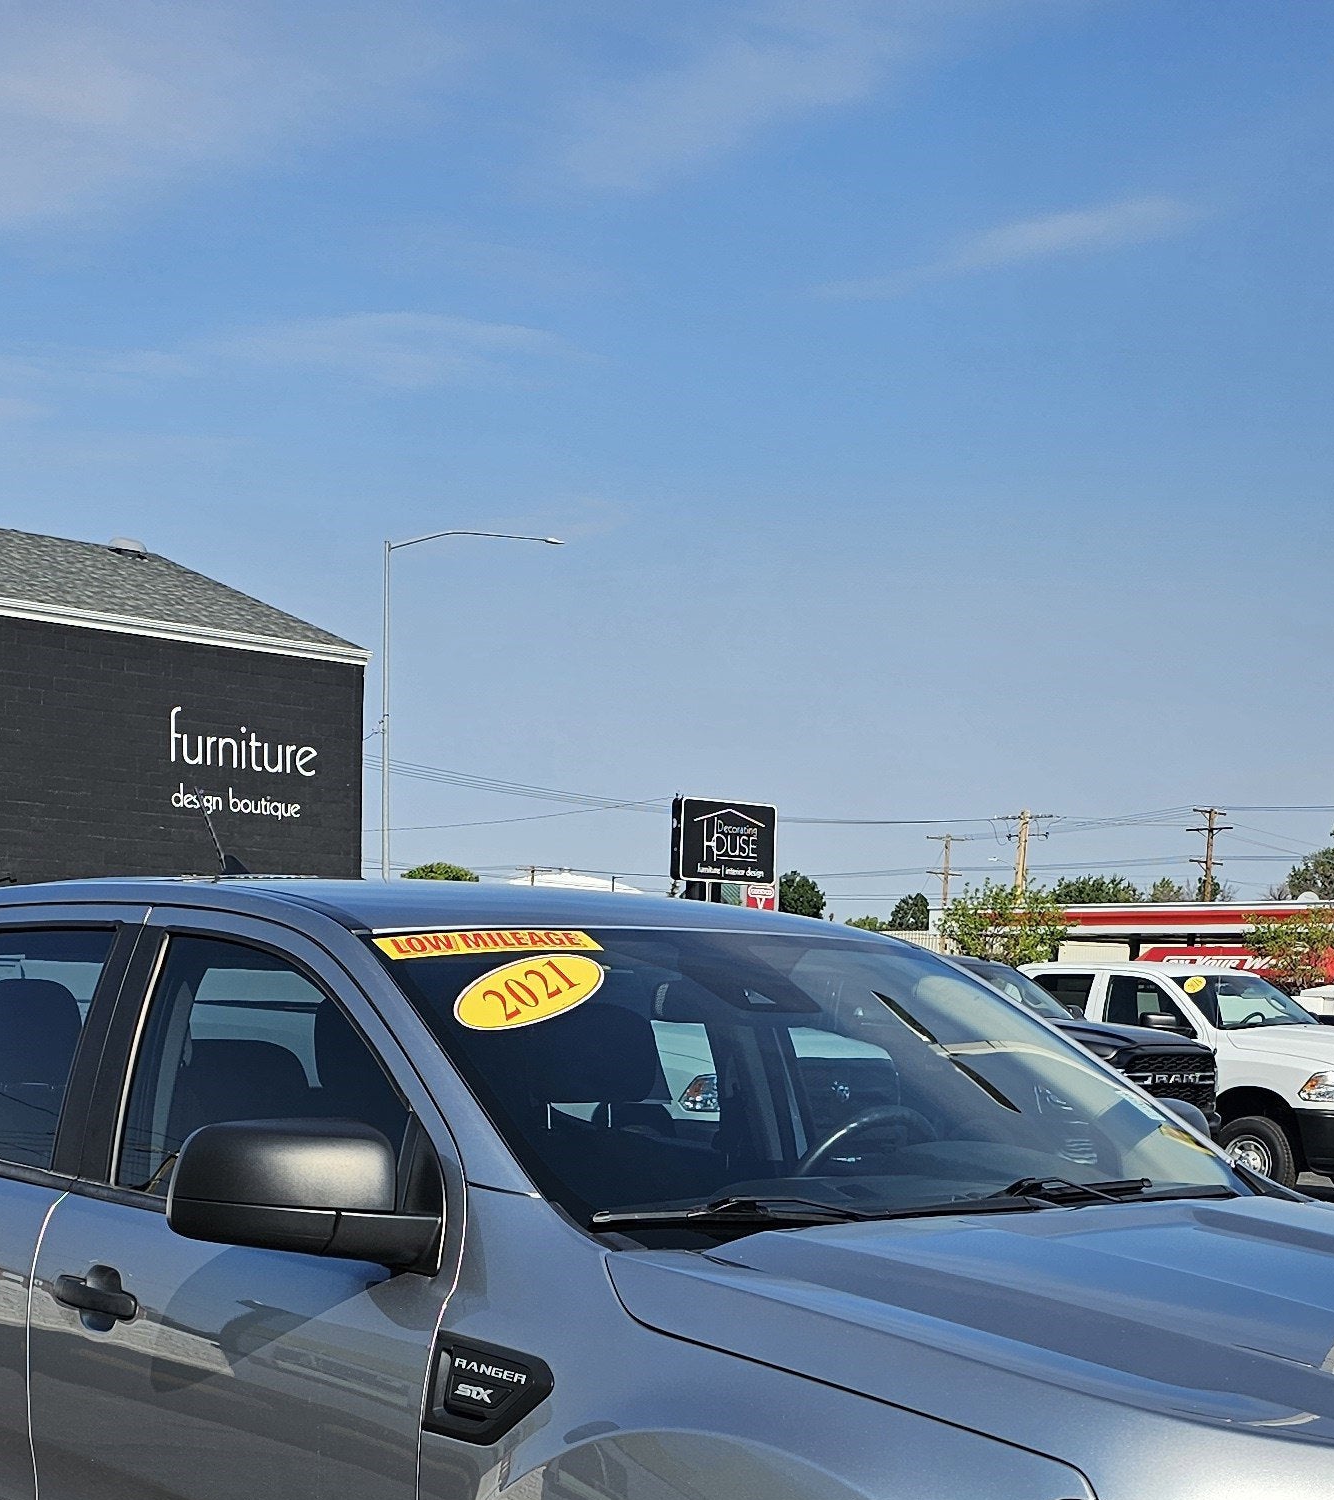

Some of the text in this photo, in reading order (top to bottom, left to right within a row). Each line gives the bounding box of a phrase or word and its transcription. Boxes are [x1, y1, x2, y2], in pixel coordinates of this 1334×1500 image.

[169, 705, 317, 777] furniture
[171, 782, 301, 820] desgn boutique
[717, 819, 758, 837] Decorating
[390, 931, 583, 954] LOW MILEAGE
[482, 960, 582, 1021] 2021
[1155, 1072, 1201, 1084] RAM
[454, 1357, 527, 1385] RANGER
[454, 1383, 494, 1404] STX
